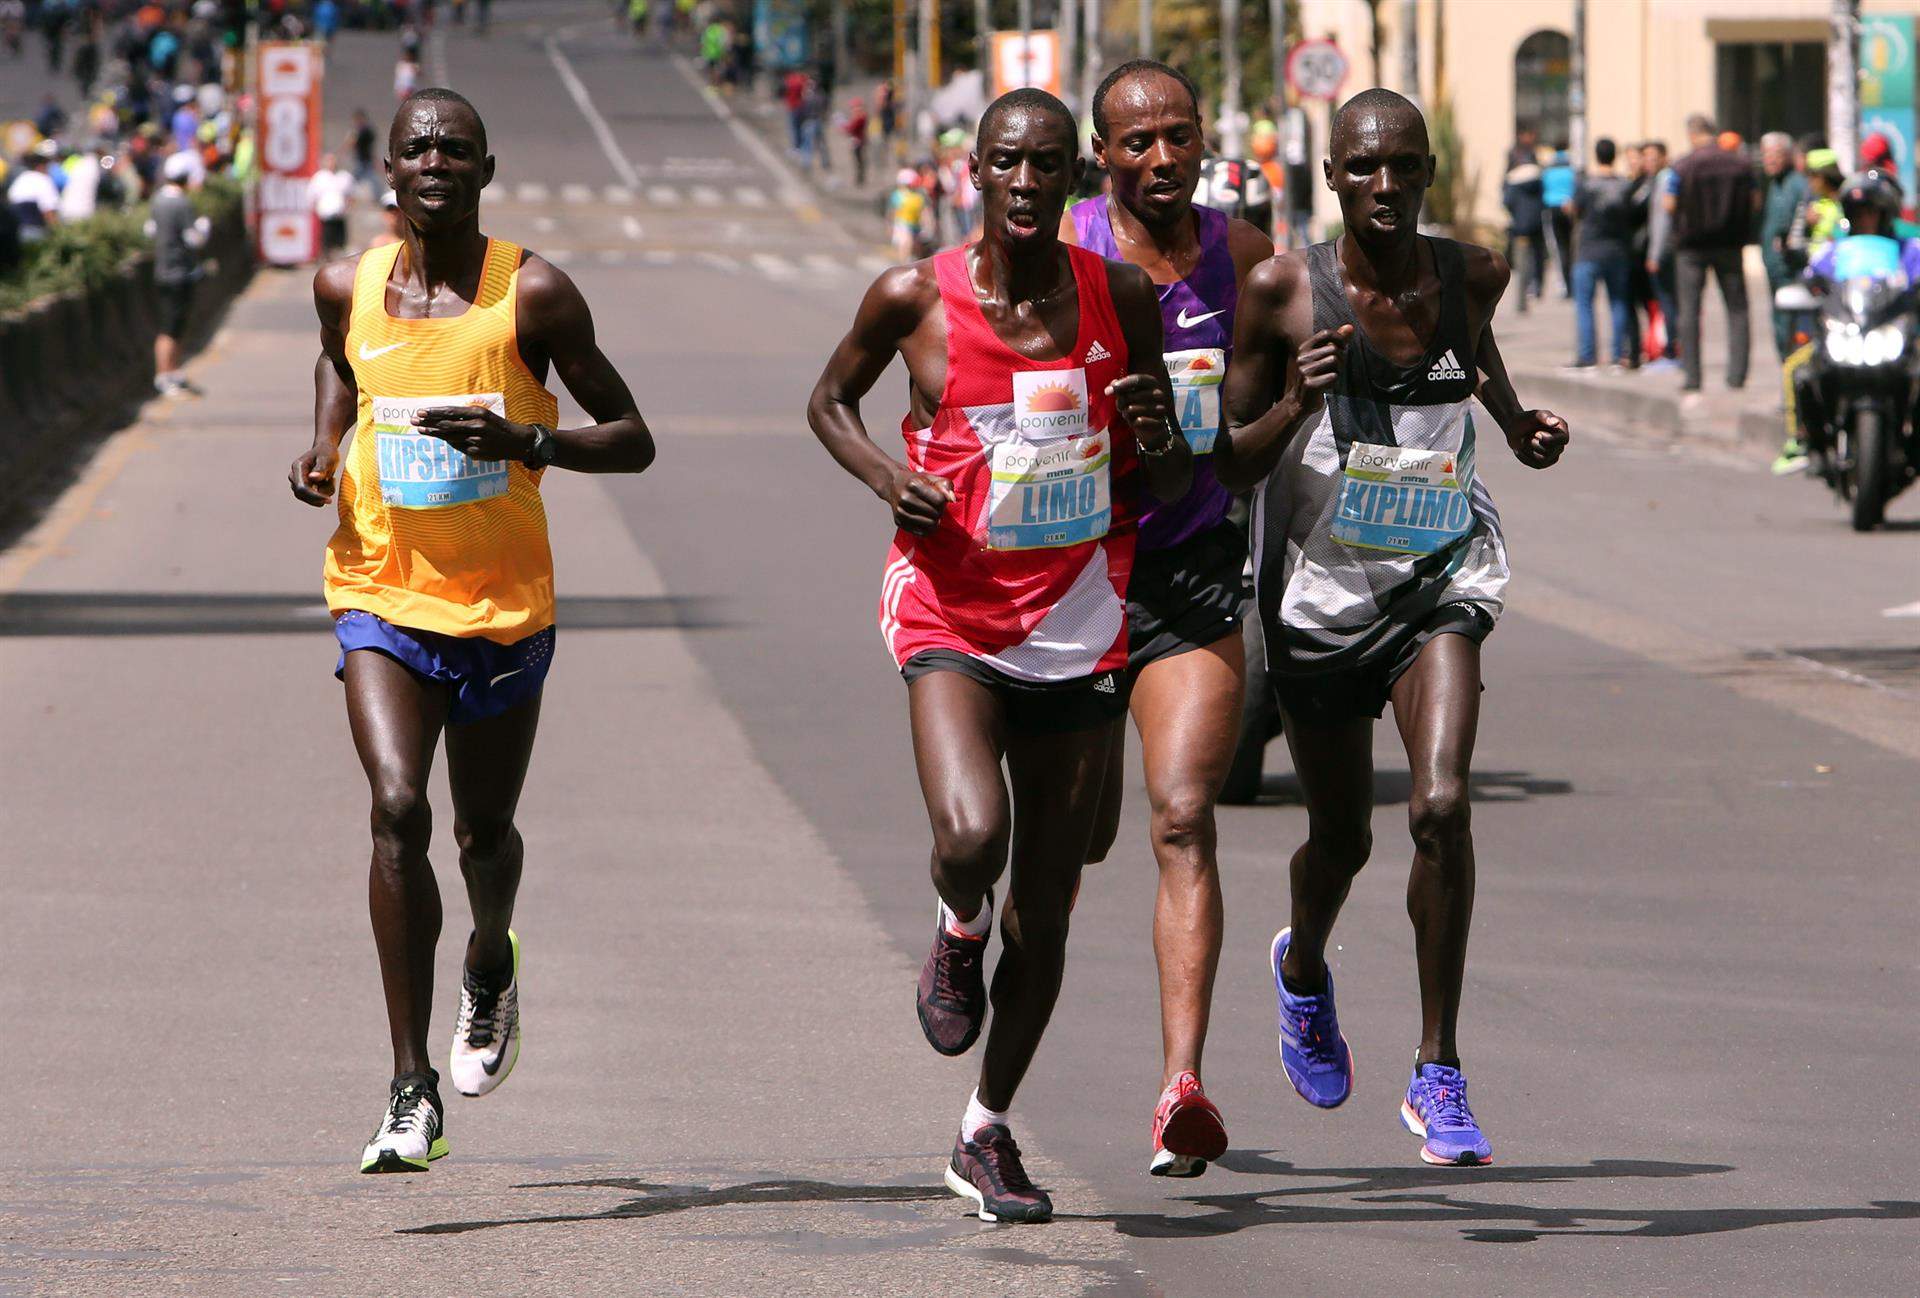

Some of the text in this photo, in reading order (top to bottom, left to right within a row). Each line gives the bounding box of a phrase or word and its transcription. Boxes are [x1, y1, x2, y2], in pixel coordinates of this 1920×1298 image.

[1085, 351, 1111, 364] adidas
[1427, 369, 1466, 381] adidas
[1020, 412, 1086, 429] porvenir
[1005, 450, 1071, 469] porvenir
[1360, 454, 1432, 472] porvenir
[1021, 475, 1096, 524] LIMO
[1342, 481, 1467, 530] KIPLIMO
